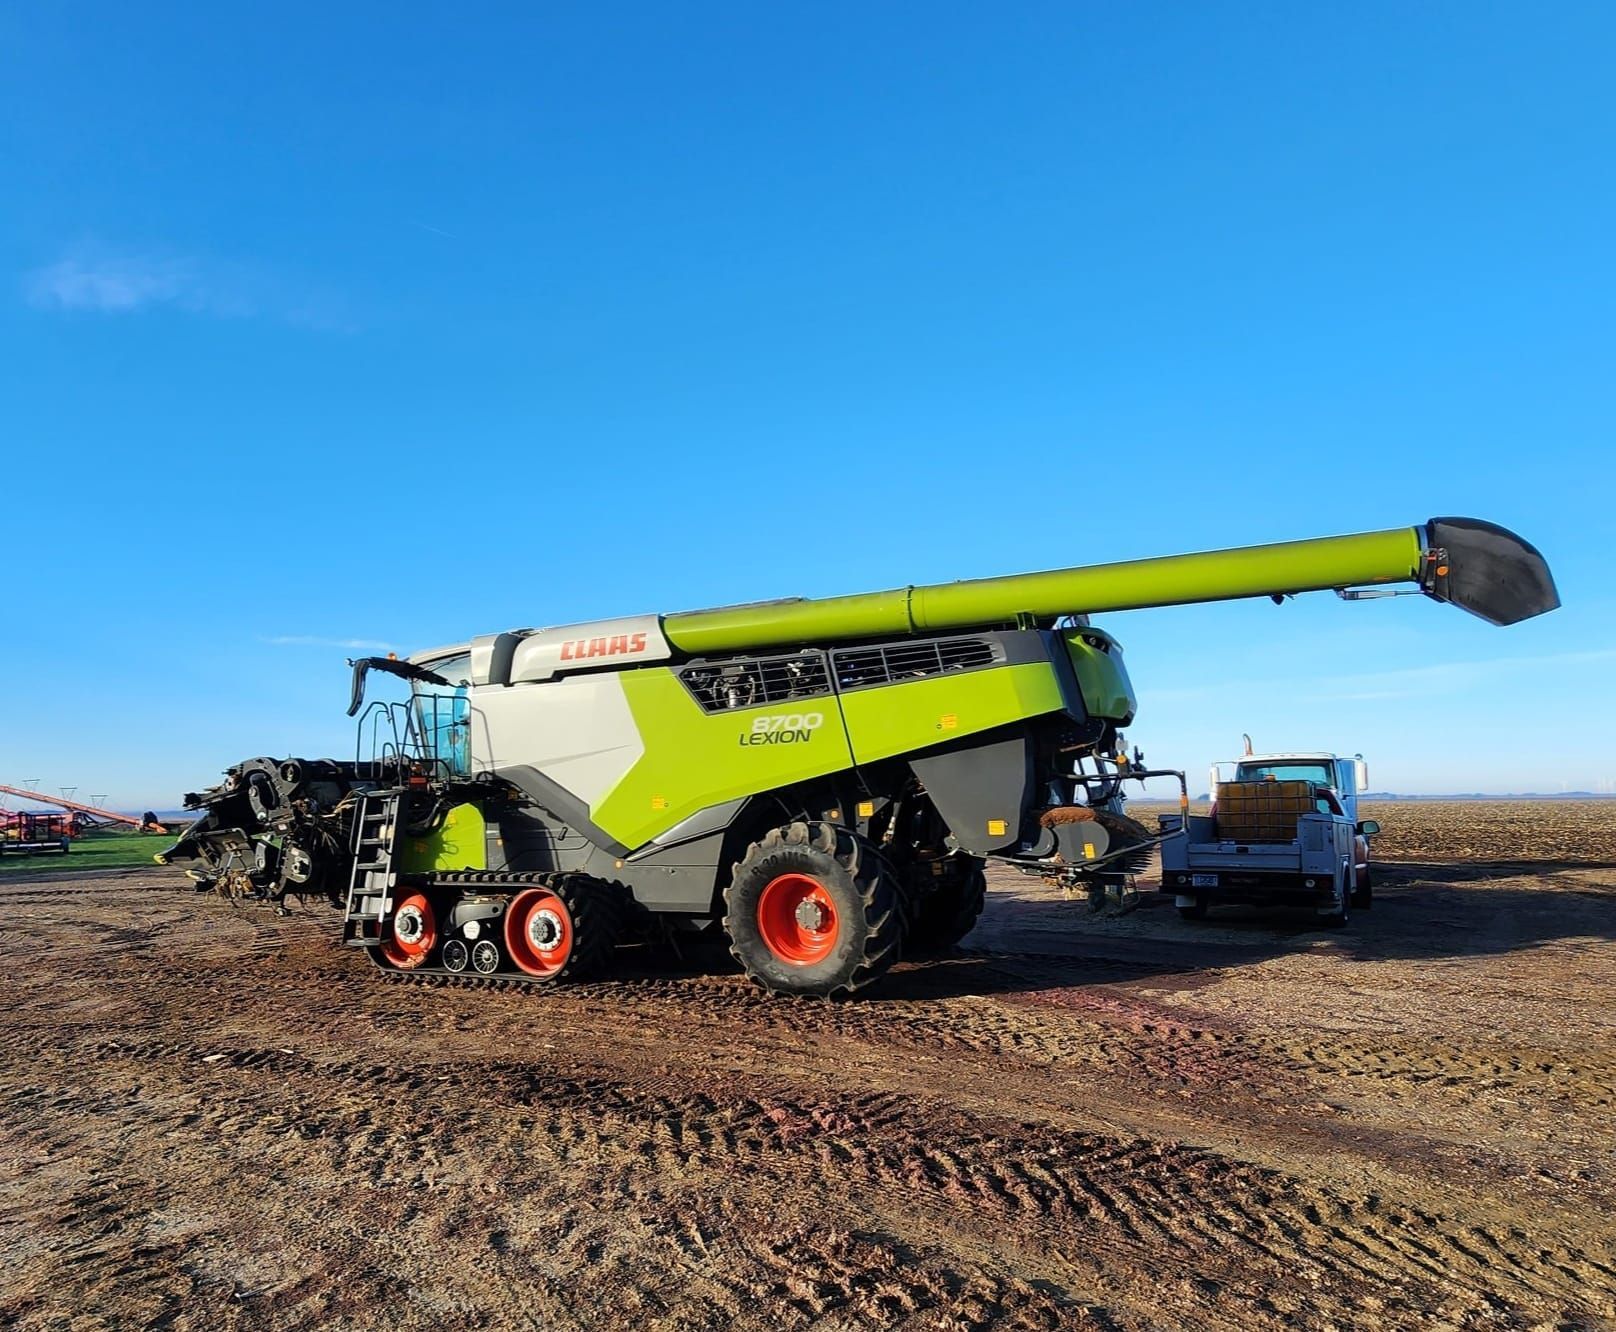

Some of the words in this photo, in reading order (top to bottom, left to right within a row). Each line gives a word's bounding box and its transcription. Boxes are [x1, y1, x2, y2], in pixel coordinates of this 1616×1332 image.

[560, 633, 647, 660] CLAAS
[752, 713, 824, 733] 8700
[739, 729, 812, 746] LEXION
